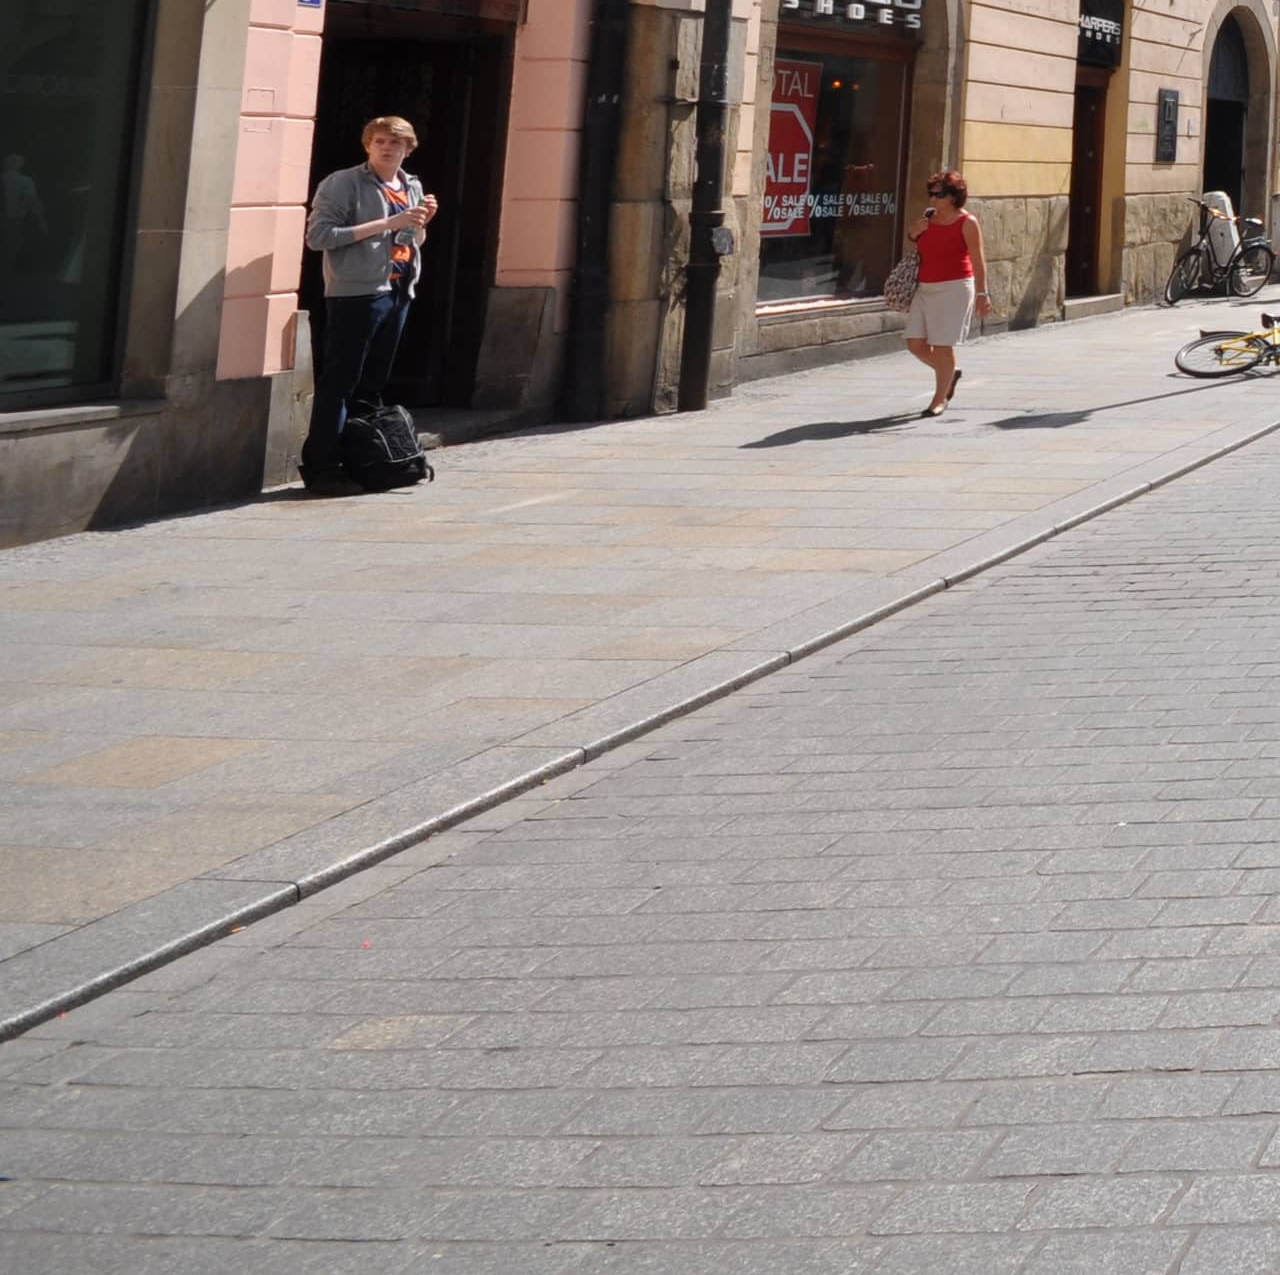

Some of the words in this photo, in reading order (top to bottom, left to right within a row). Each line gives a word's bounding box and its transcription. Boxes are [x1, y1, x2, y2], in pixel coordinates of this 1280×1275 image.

[774, 69, 814, 98] TAL
[766, 152, 809, 183] ALE
[781, 194, 807, 207] SALE
[822, 193, 845, 206] SALE
[860, 192, 881, 204] SALE
[781, 206, 804, 220] SALE
[822, 205, 844, 218] SALE
[860, 204, 880, 216] SALE
